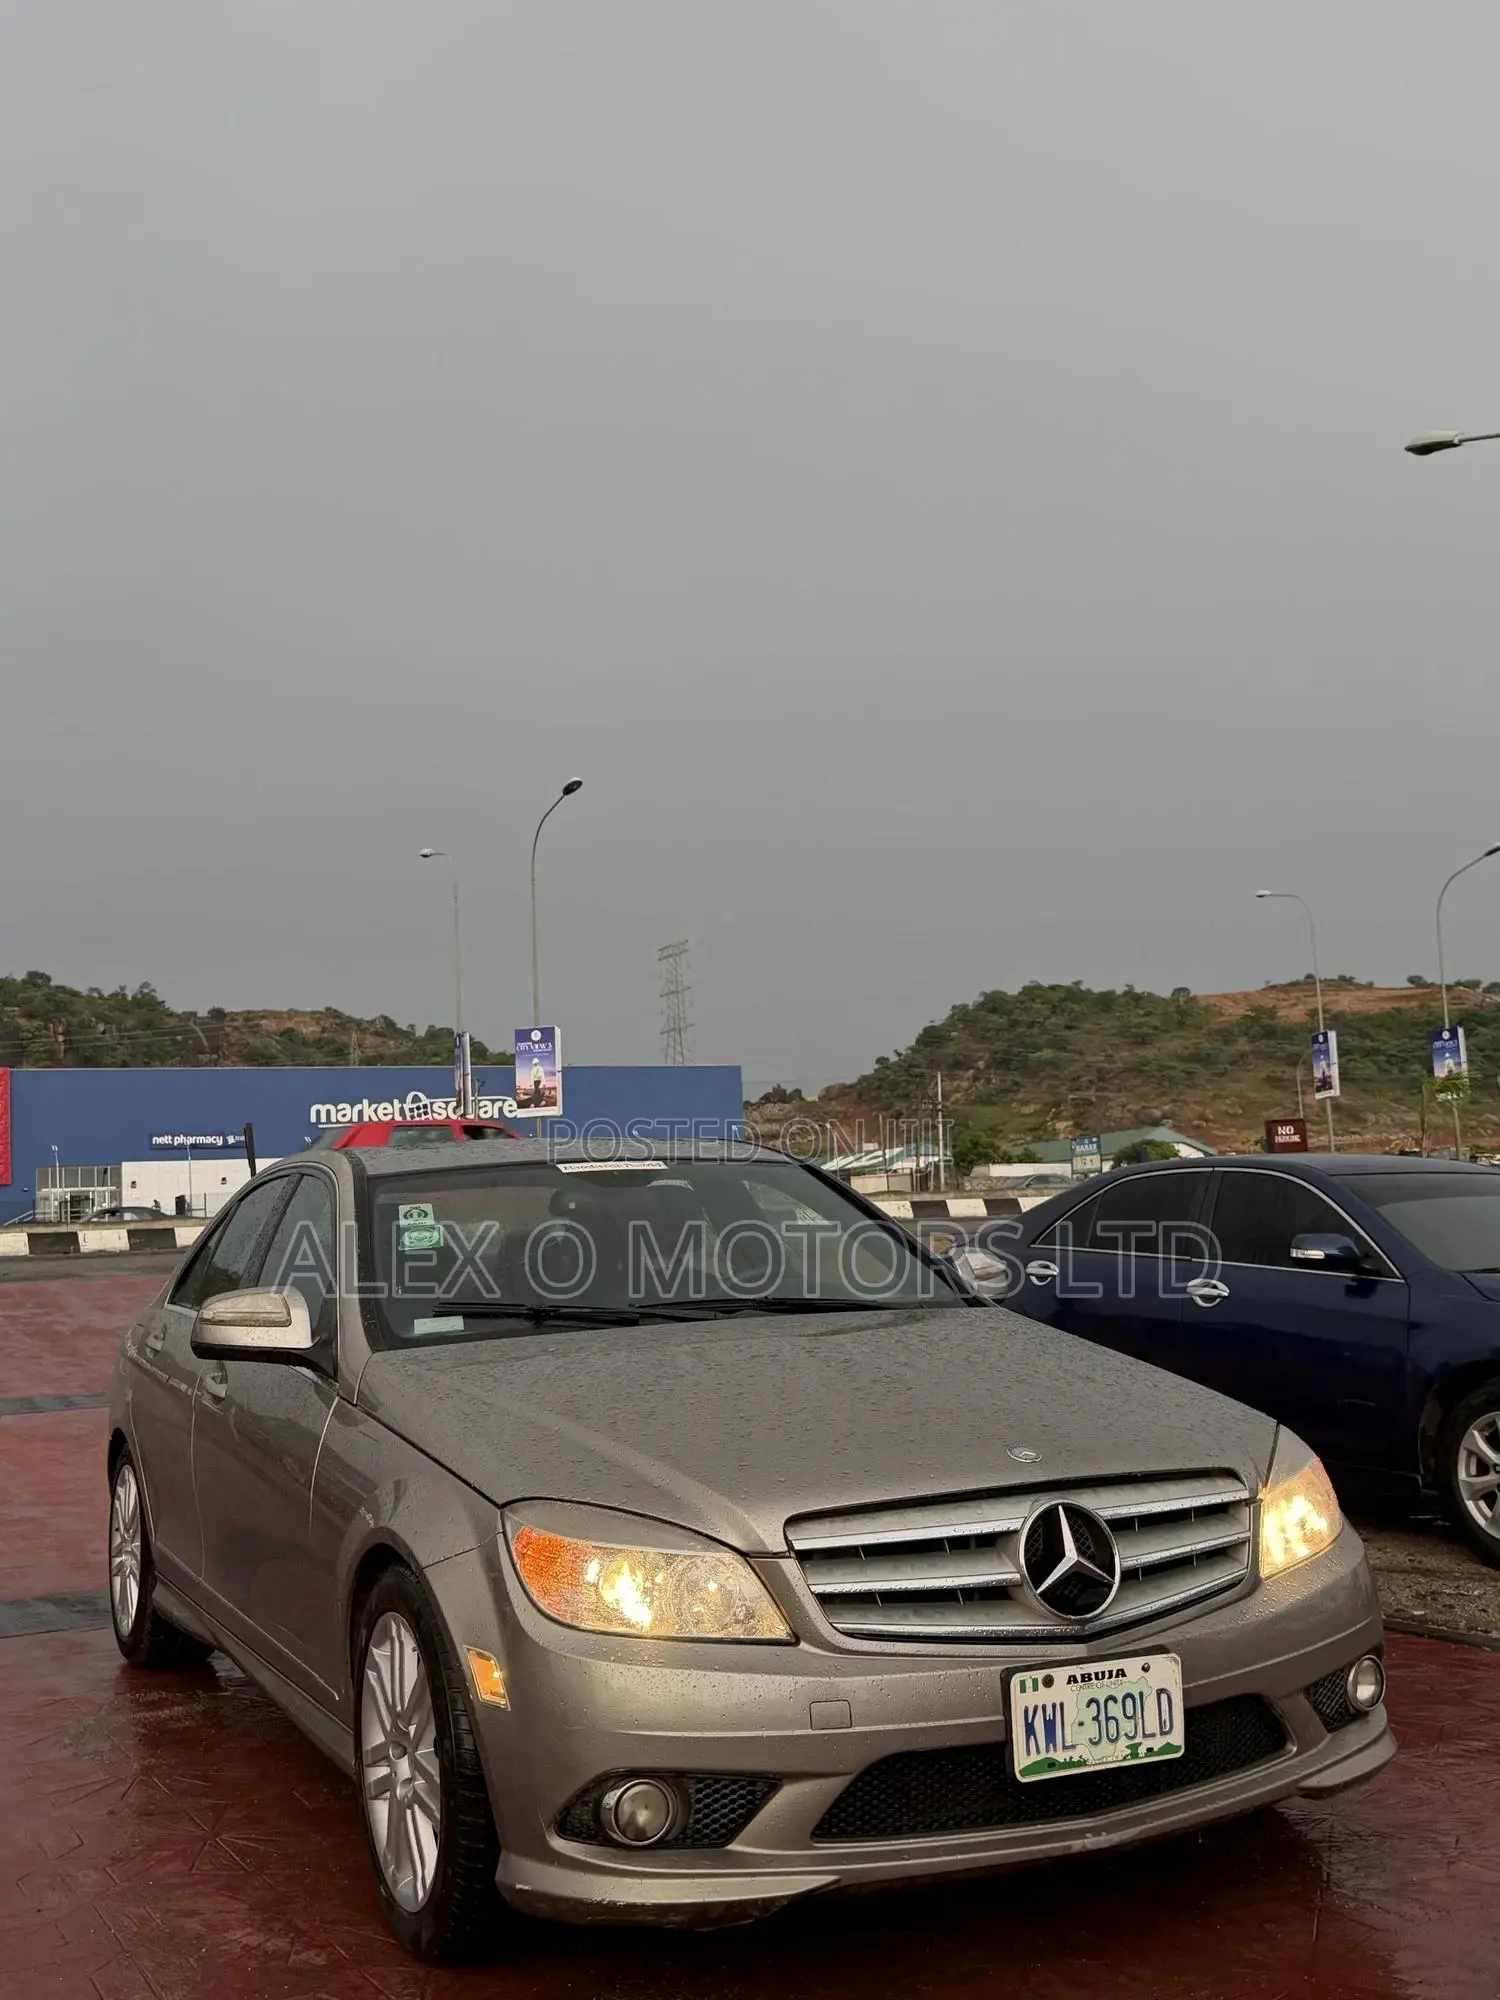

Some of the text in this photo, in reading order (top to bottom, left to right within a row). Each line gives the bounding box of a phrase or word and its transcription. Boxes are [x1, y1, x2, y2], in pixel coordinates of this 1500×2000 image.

[310, 1099, 405, 1123] market
[1277, 1125, 1295, 1135] NO
[152, 1134, 172, 1144] nett
[173, 1134, 223, 1146] pharmacy
[1066, 1668, 1127, 1685] ABUJA
